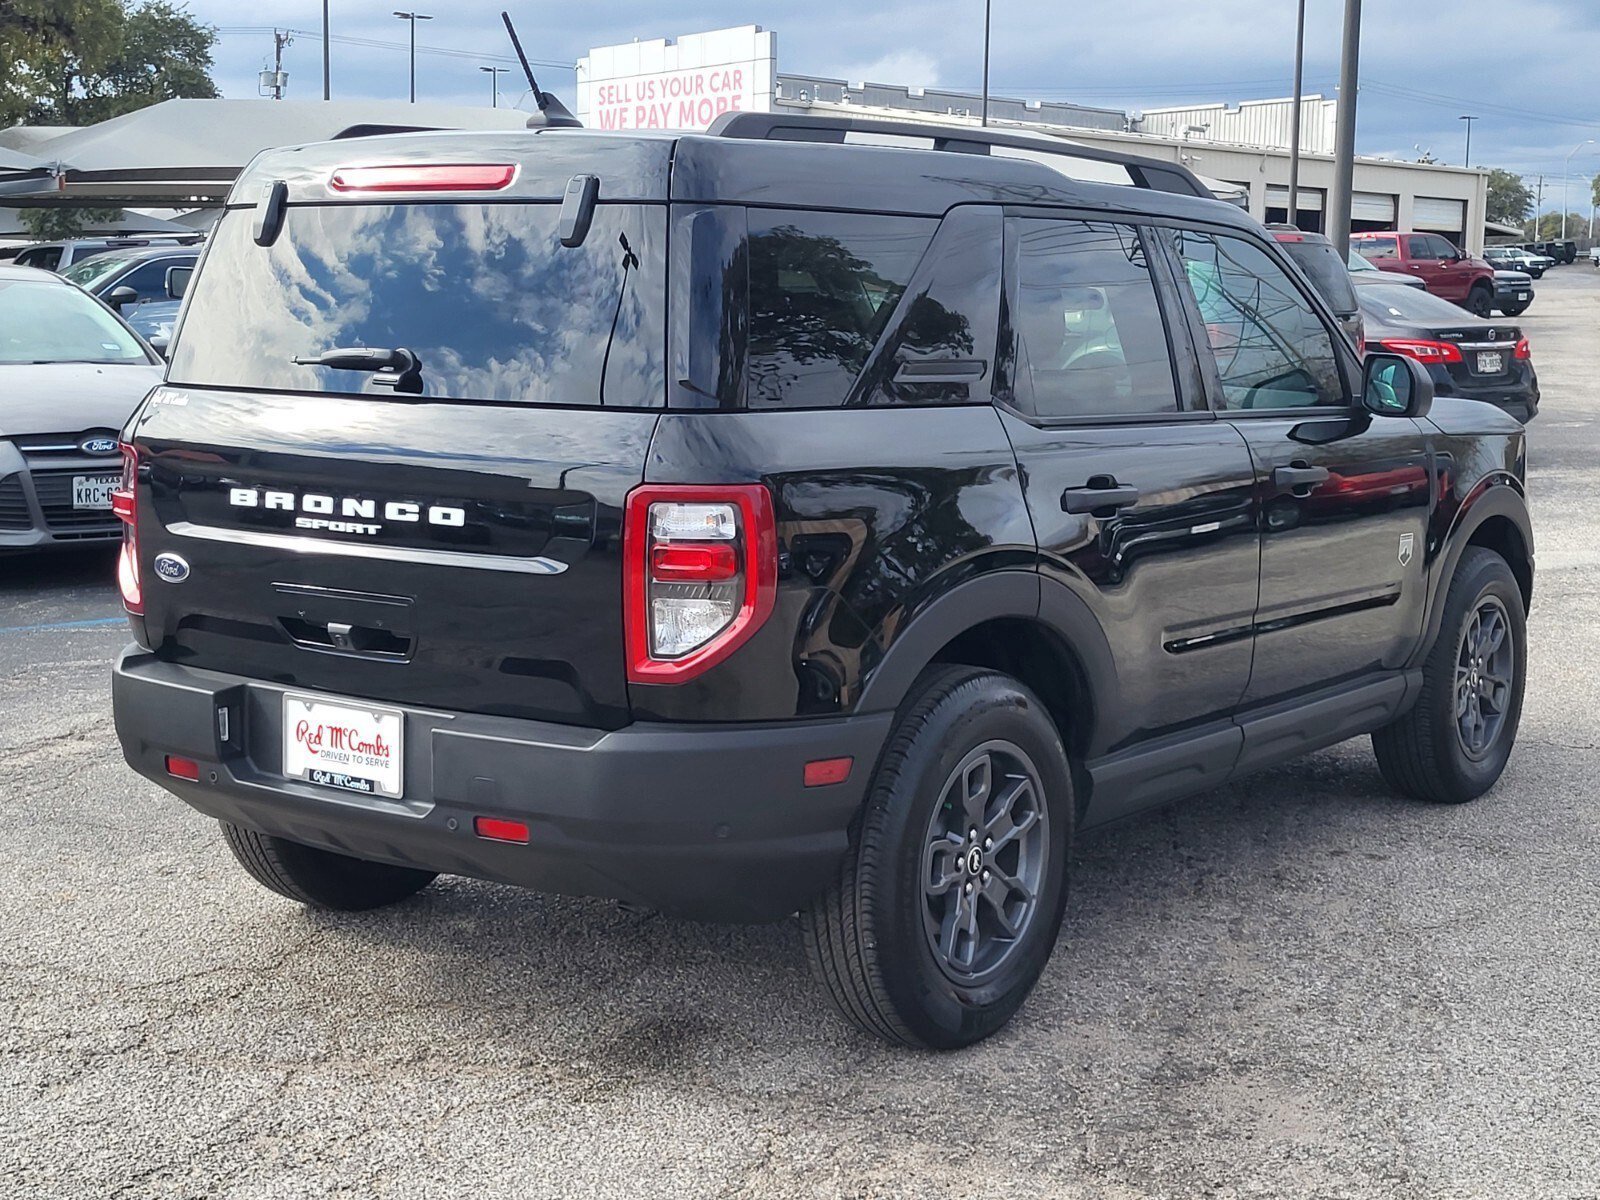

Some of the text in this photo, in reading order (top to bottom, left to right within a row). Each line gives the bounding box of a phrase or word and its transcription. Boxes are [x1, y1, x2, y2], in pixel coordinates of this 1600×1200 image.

[599, 69, 743, 106] SELL US YOUR CAR
[599, 107, 628, 130] WE
[635, 102, 672, 128] PAY
[95, 476, 120, 484] TEXAS
[229, 488, 466, 527] BRONCO
[295, 517, 382, 535] SPORT
[296, 719, 390, 758] Red McCombs
[320, 749, 390, 769] DRIVEN TO SERVE
[313, 770, 370, 791] Red McCombs
